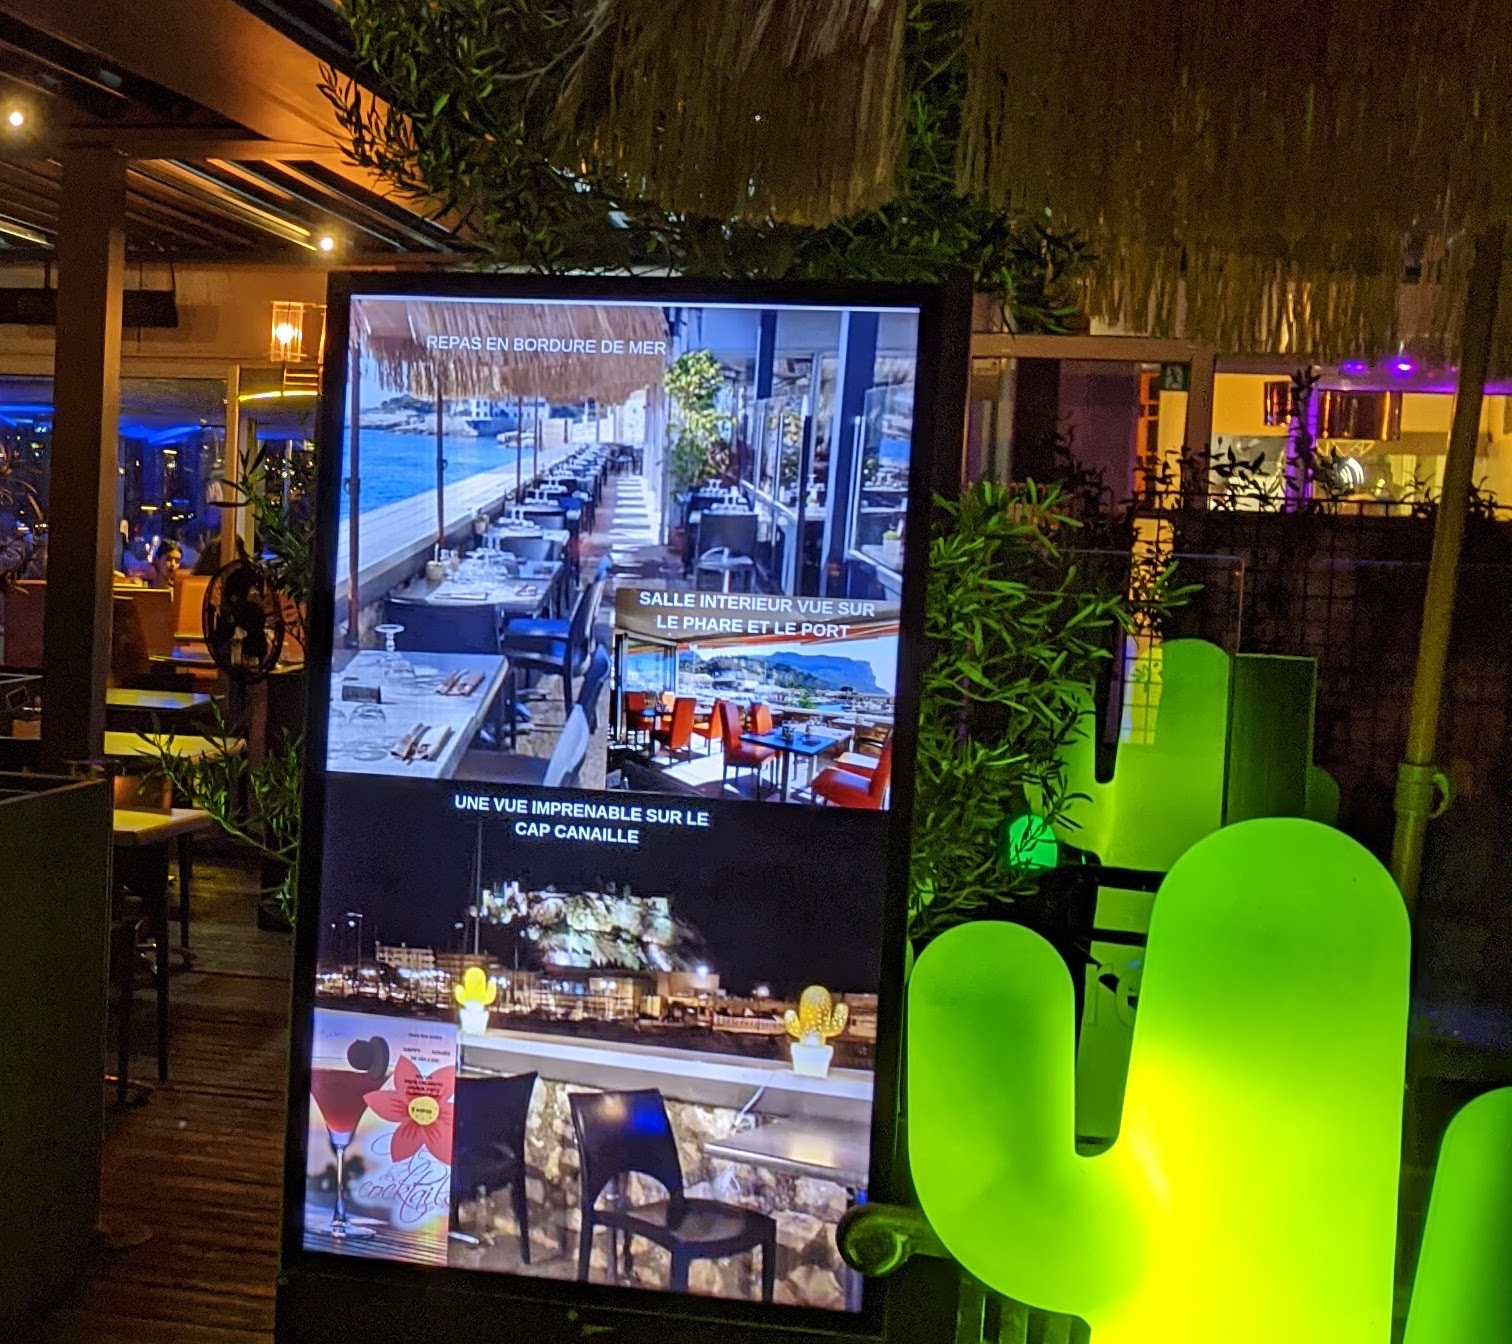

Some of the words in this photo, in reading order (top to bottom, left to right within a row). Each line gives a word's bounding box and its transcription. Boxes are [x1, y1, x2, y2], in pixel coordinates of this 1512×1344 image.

[426, 335, 481, 351] REPAS
[486, 336, 509, 351] EN
[513, 338, 596, 353] BORDURE
[601, 340, 624, 354] DE
[628, 340, 667, 355] MER
[639, 591, 696, 608] SALLE
[700, 593, 793, 613] INTERIEUR
[796, 599, 834, 615] VUE
[837, 601, 876, 617] SUR
[656, 615, 679, 629] LE
[683, 616, 743, 633] PHARE
[747, 620, 771, 634] ET
[774, 621, 797, 636] LE
[801, 622, 851, 638] PORT
[454, 794, 490, 811] UNE
[493, 797, 529, 814] VUE
[531, 800, 643, 822] IMPRENABLE
[645, 808, 683, 824] SUR
[686, 811, 710, 827] LE
[514, 821, 551, 837] CAP
[554, 824, 640, 844] CANAILLE
